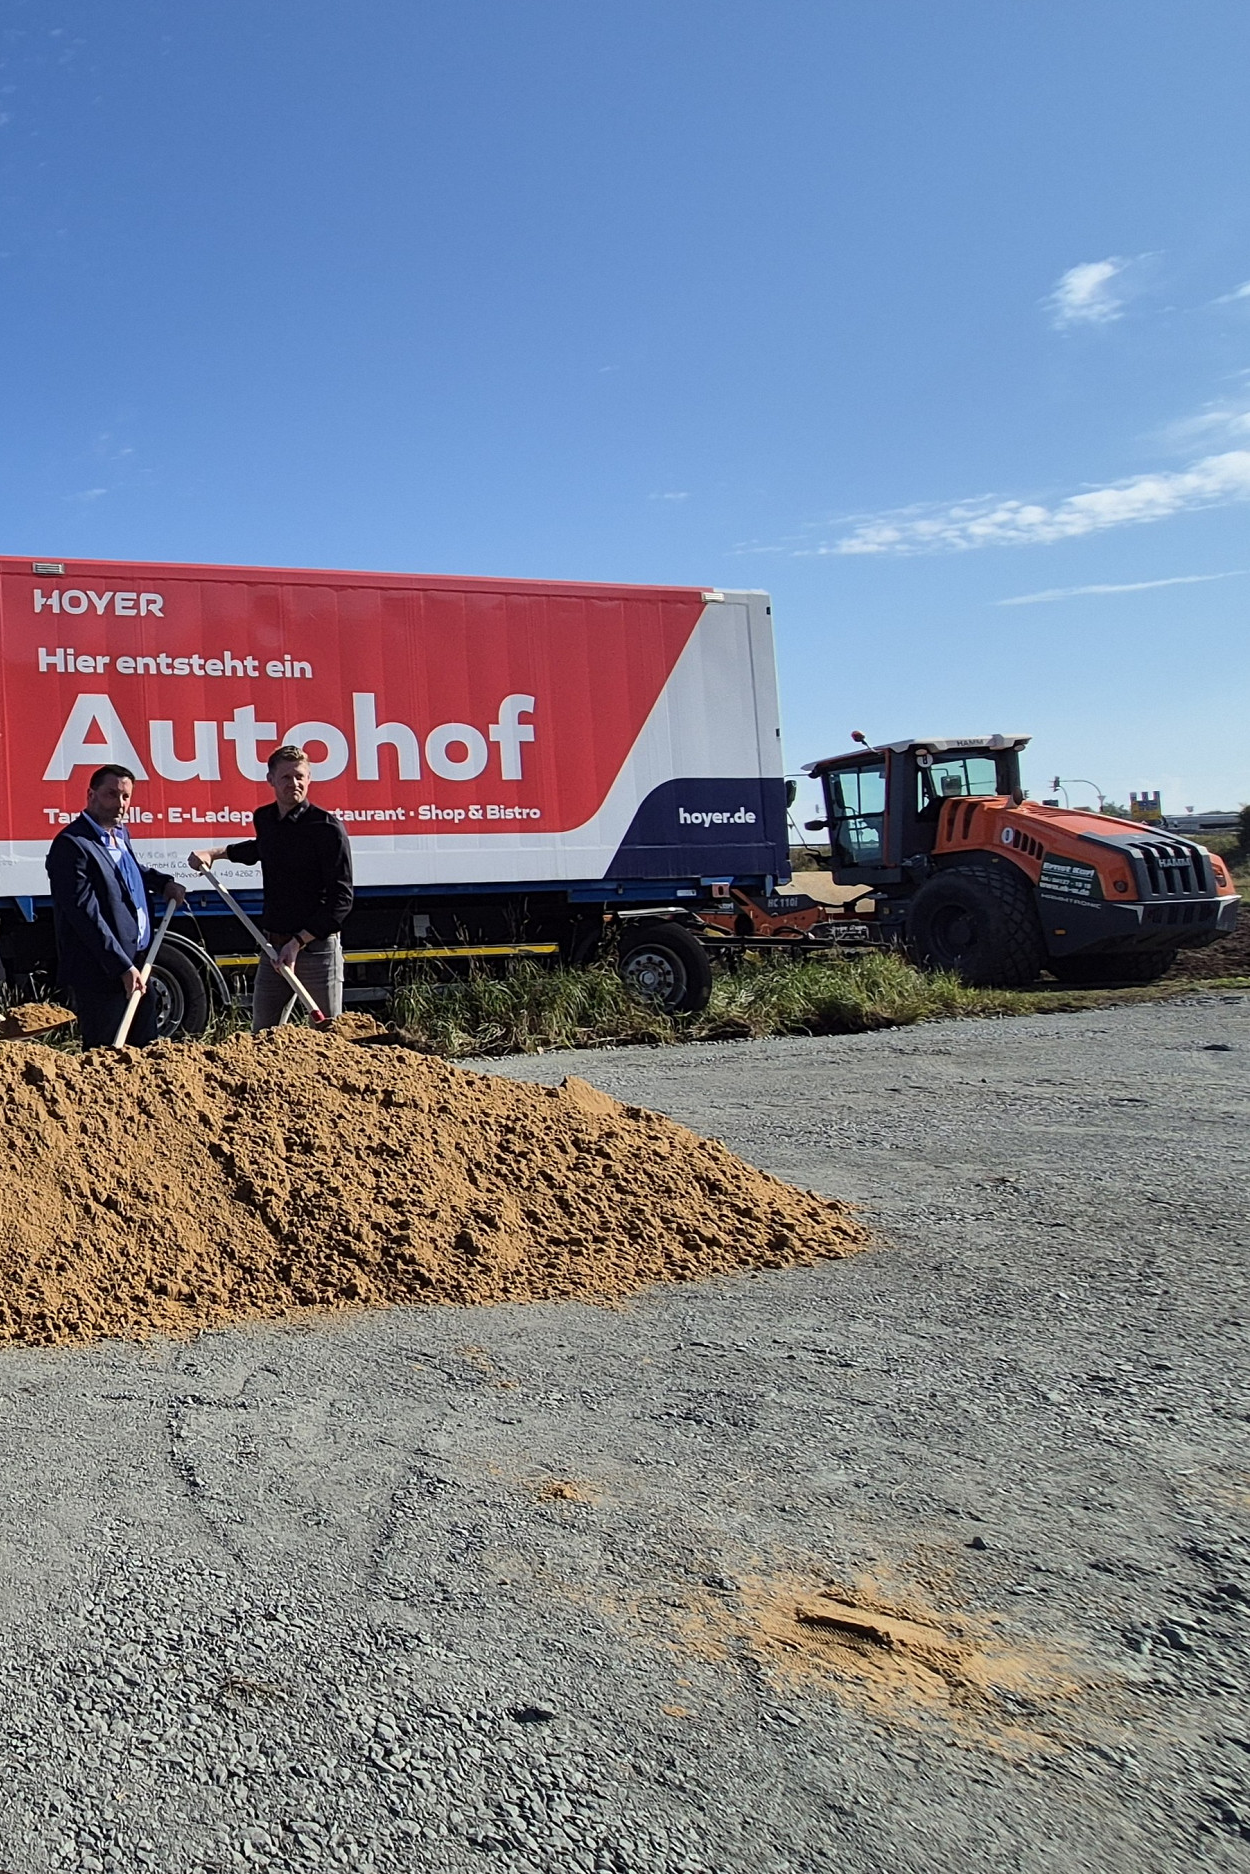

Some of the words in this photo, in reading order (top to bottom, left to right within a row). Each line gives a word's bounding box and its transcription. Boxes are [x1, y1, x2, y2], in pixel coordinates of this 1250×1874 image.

[34, 589, 164, 617] HOYER
[38, 647, 110, 674] Hier
[116, 650, 259, 678] entsteht
[266, 654, 313, 678] ein
[42, 692, 536, 782] Autohof
[44, 807, 153, 824] Taelle
[168, 807, 254, 826] E-Ladep
[328, 806, 405, 821] taurant
[418, 804, 466, 823] Shop
[468, 805, 483, 820] &
[486, 804, 541, 820] Bistro
[678, 806, 756, 828] hoyer.de
[768, 898, 778, 908] HC
